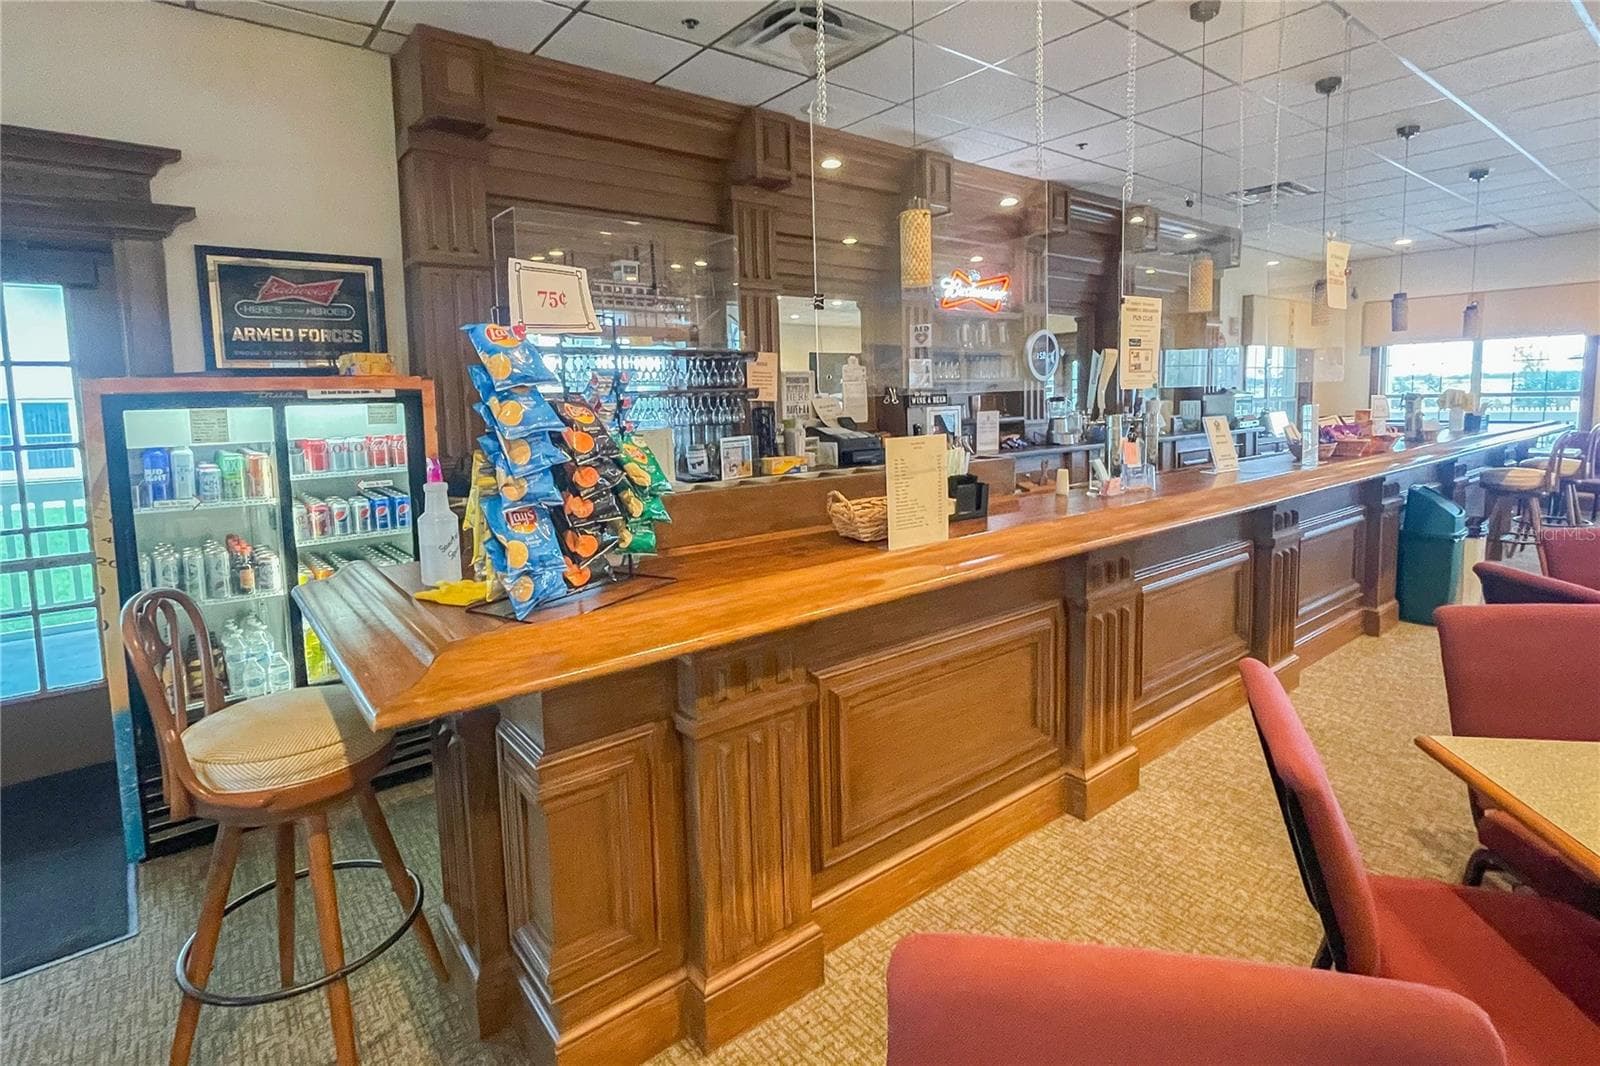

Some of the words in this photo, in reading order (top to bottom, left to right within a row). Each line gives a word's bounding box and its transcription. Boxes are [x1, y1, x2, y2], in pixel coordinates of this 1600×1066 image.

[537, 289, 567, 308] 75¢
[305, 306, 348, 316] HEROES
[232, 326, 294, 342] ARMED
[298, 328, 363, 343] FORCES
[914, 325, 930, 333] AED
